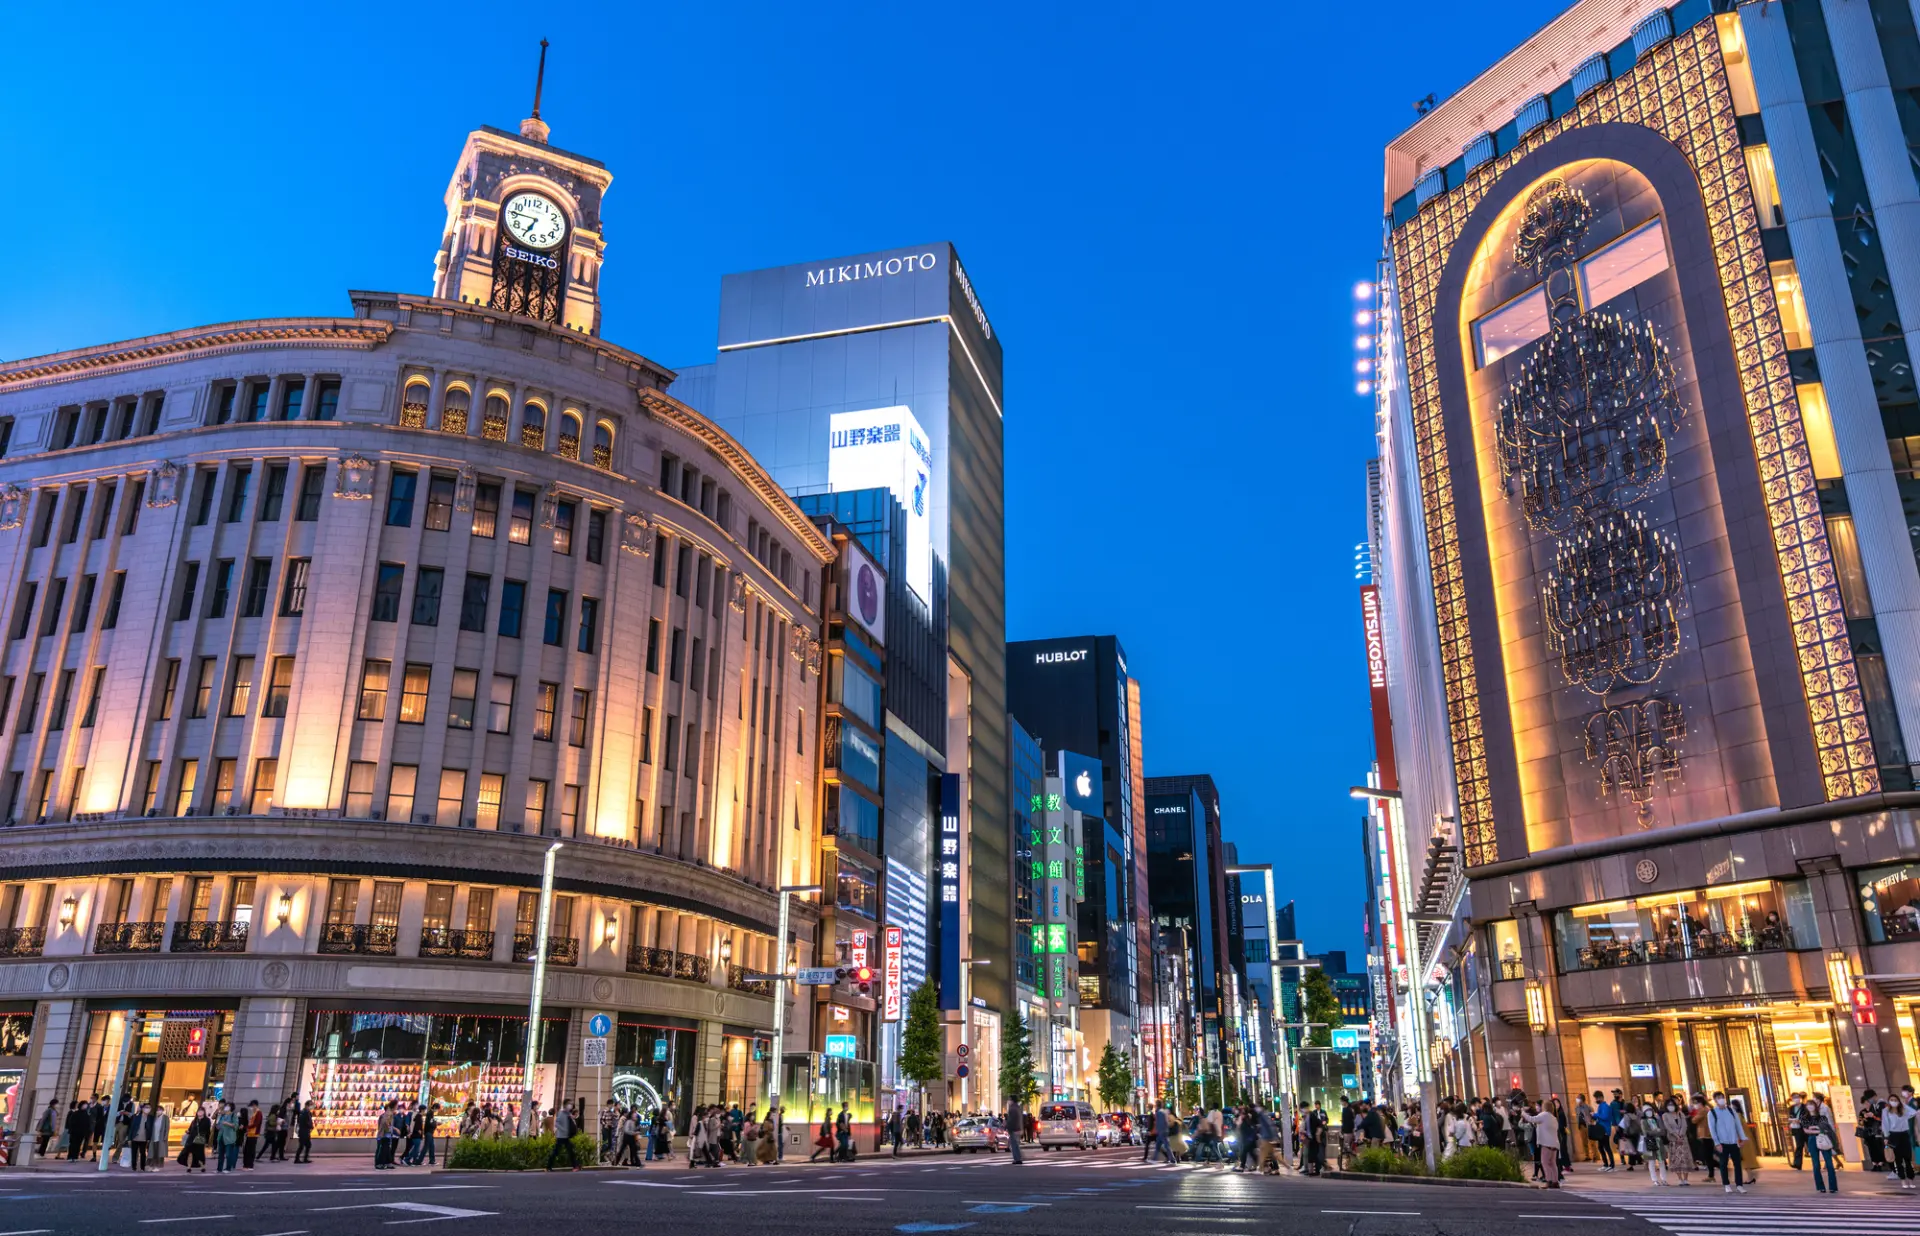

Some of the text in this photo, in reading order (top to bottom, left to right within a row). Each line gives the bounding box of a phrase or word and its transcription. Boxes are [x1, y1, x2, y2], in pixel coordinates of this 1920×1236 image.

[506, 247, 557, 269] SEIKO
[806, 252, 936, 287] MIKIMOTO
[955, 260, 991, 340] MIKIMOTO
[831, 423, 900, 449] 山野楽器
[1363, 591, 1385, 688] MITSUKOSHI
[1035, 650, 1088, 664] HUBLOT
[1154, 806, 1186, 814] CHANEL
[1046, 793, 1063, 879] 教文館
[942, 816, 958, 902] 山野楽器
[1241, 895, 1263, 904] OLA
[1050, 928, 1065, 950] 本
[888, 952, 900, 1015] キムラヤのパン
